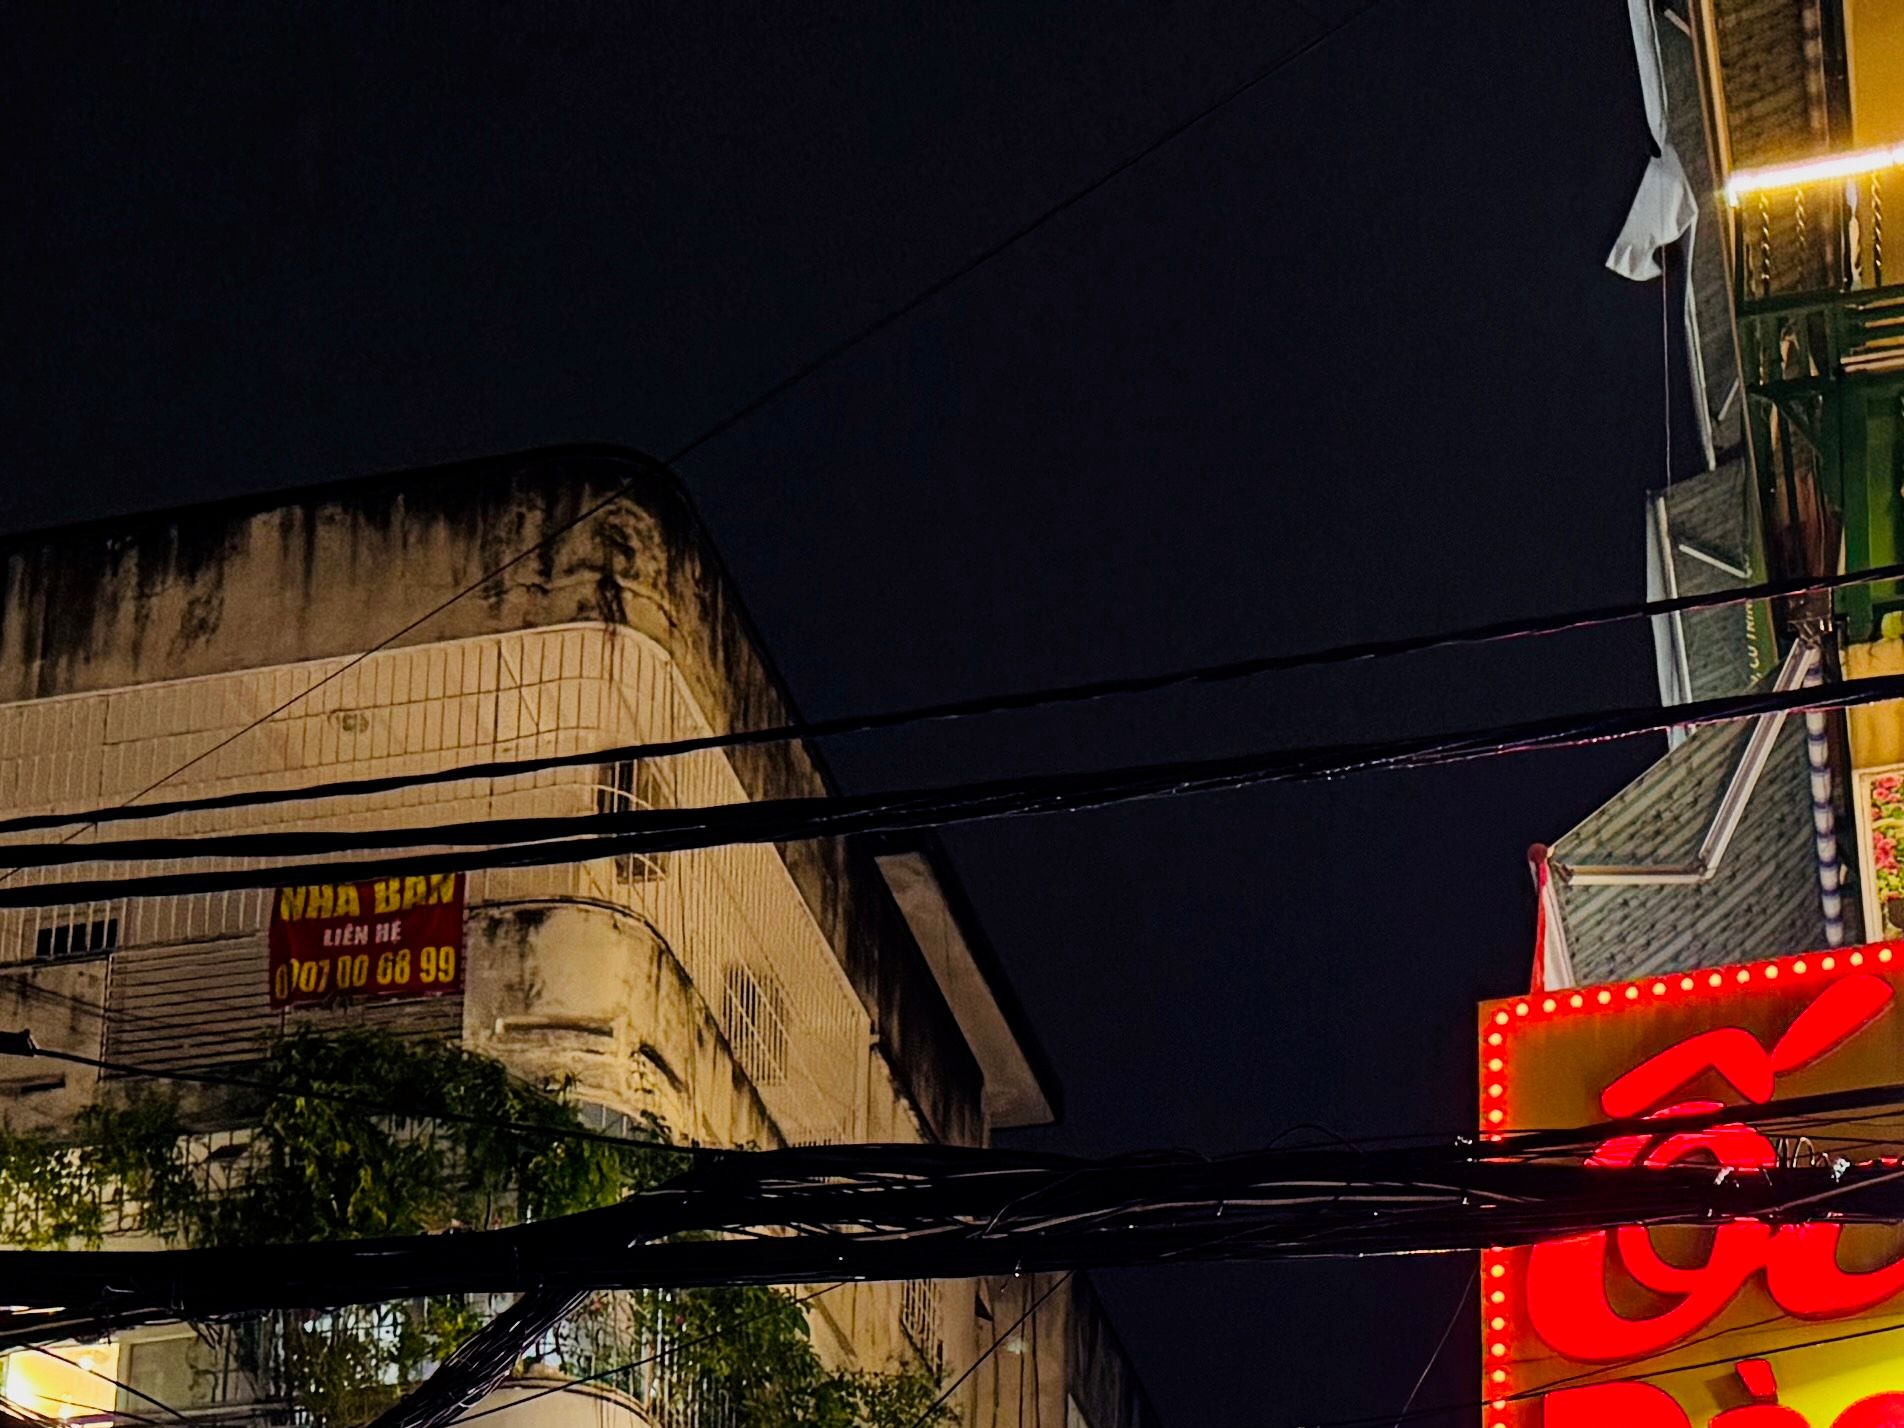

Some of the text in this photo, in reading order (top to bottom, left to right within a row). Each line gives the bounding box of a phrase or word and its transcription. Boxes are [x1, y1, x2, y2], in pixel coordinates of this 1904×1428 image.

[323, 921, 368, 947] LIÊN
[336, 954, 368, 988] 00
[376, 949, 410, 985] 68
[419, 944, 457, 984] 99
